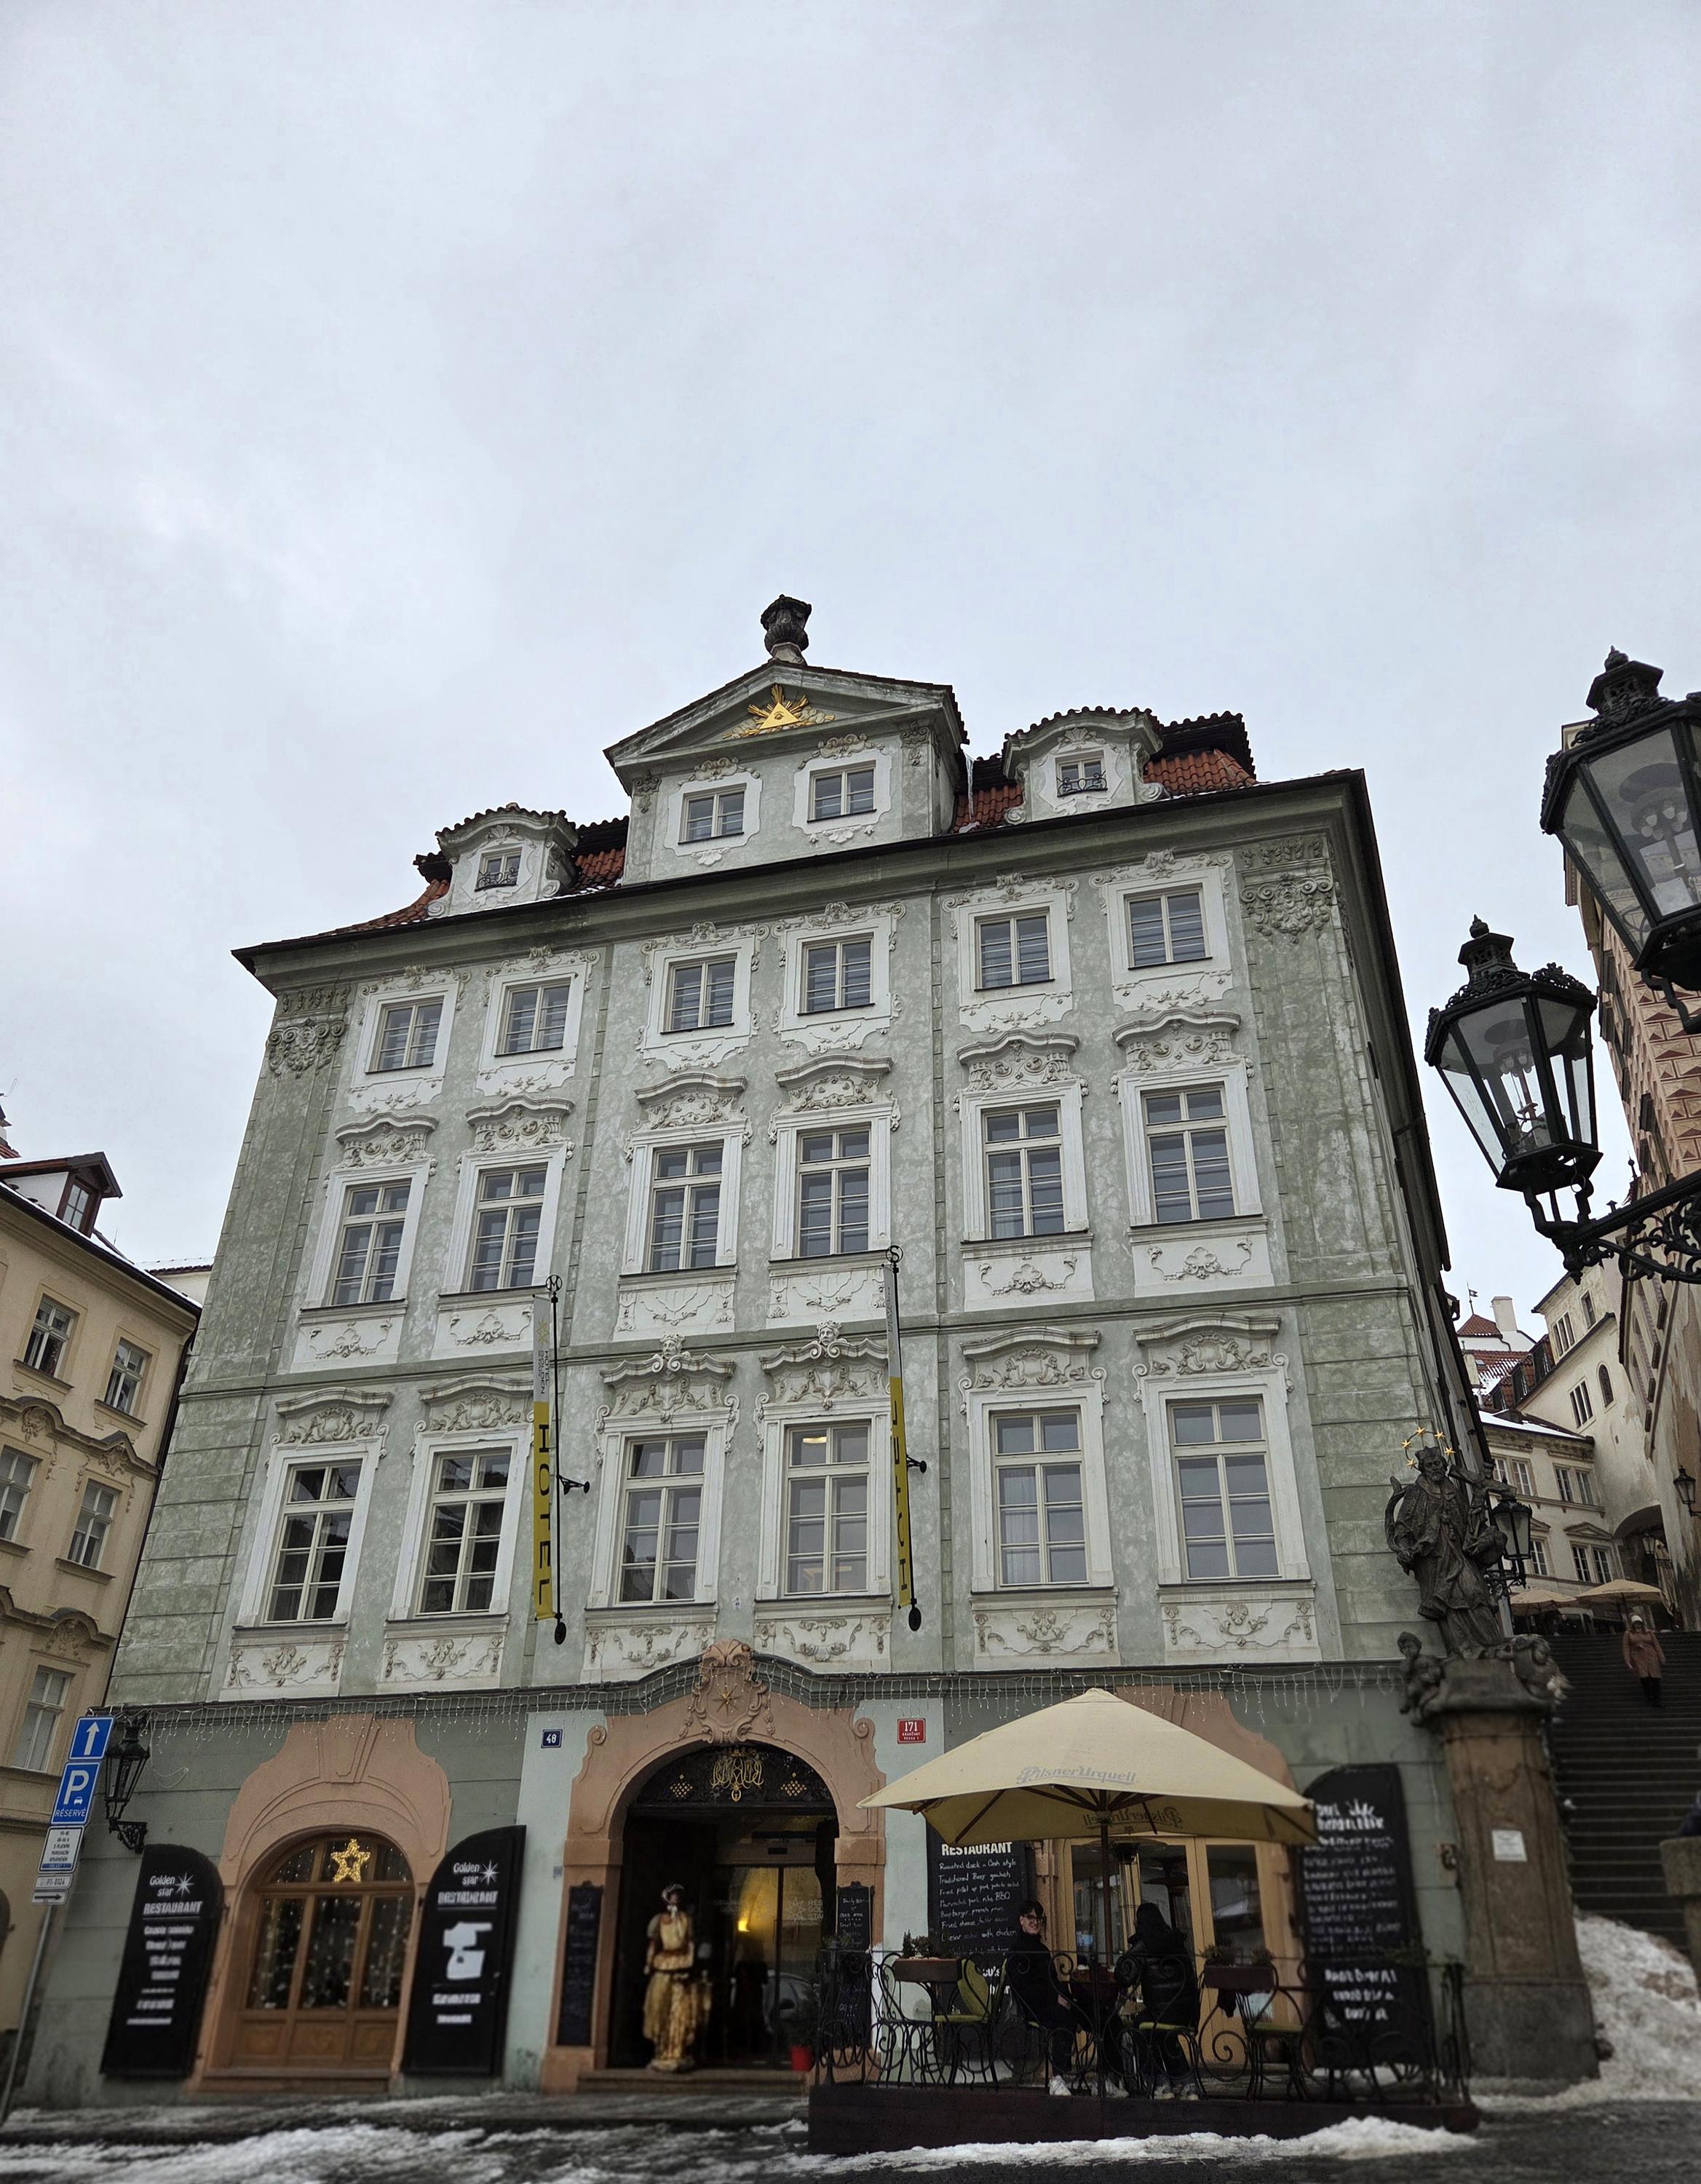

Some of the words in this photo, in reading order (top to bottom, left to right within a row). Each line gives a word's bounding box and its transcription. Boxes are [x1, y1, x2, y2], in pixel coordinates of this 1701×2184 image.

[539, 1424, 551, 1605] HOTEL
[905, 1721, 918, 1732] 171
[546, 1733, 557, 1744] 48
[63, 1770, 89, 1805] P
[55, 1807, 87, 1818] RÉSERVÉ
[941, 1842, 1012, 1856] RESTAURANT
[453, 1862, 480, 1874] Golden
[149, 1875, 175, 1886] Golden
[462, 1875, 479, 1886] star
[157, 1887, 174, 1897] star
[995, 1891, 1011, 1901] BBQ
[143, 1901, 203, 1915] RESTAURANT
[942, 1921, 958, 1930] Fried
[981, 1927, 994, 1938] with
